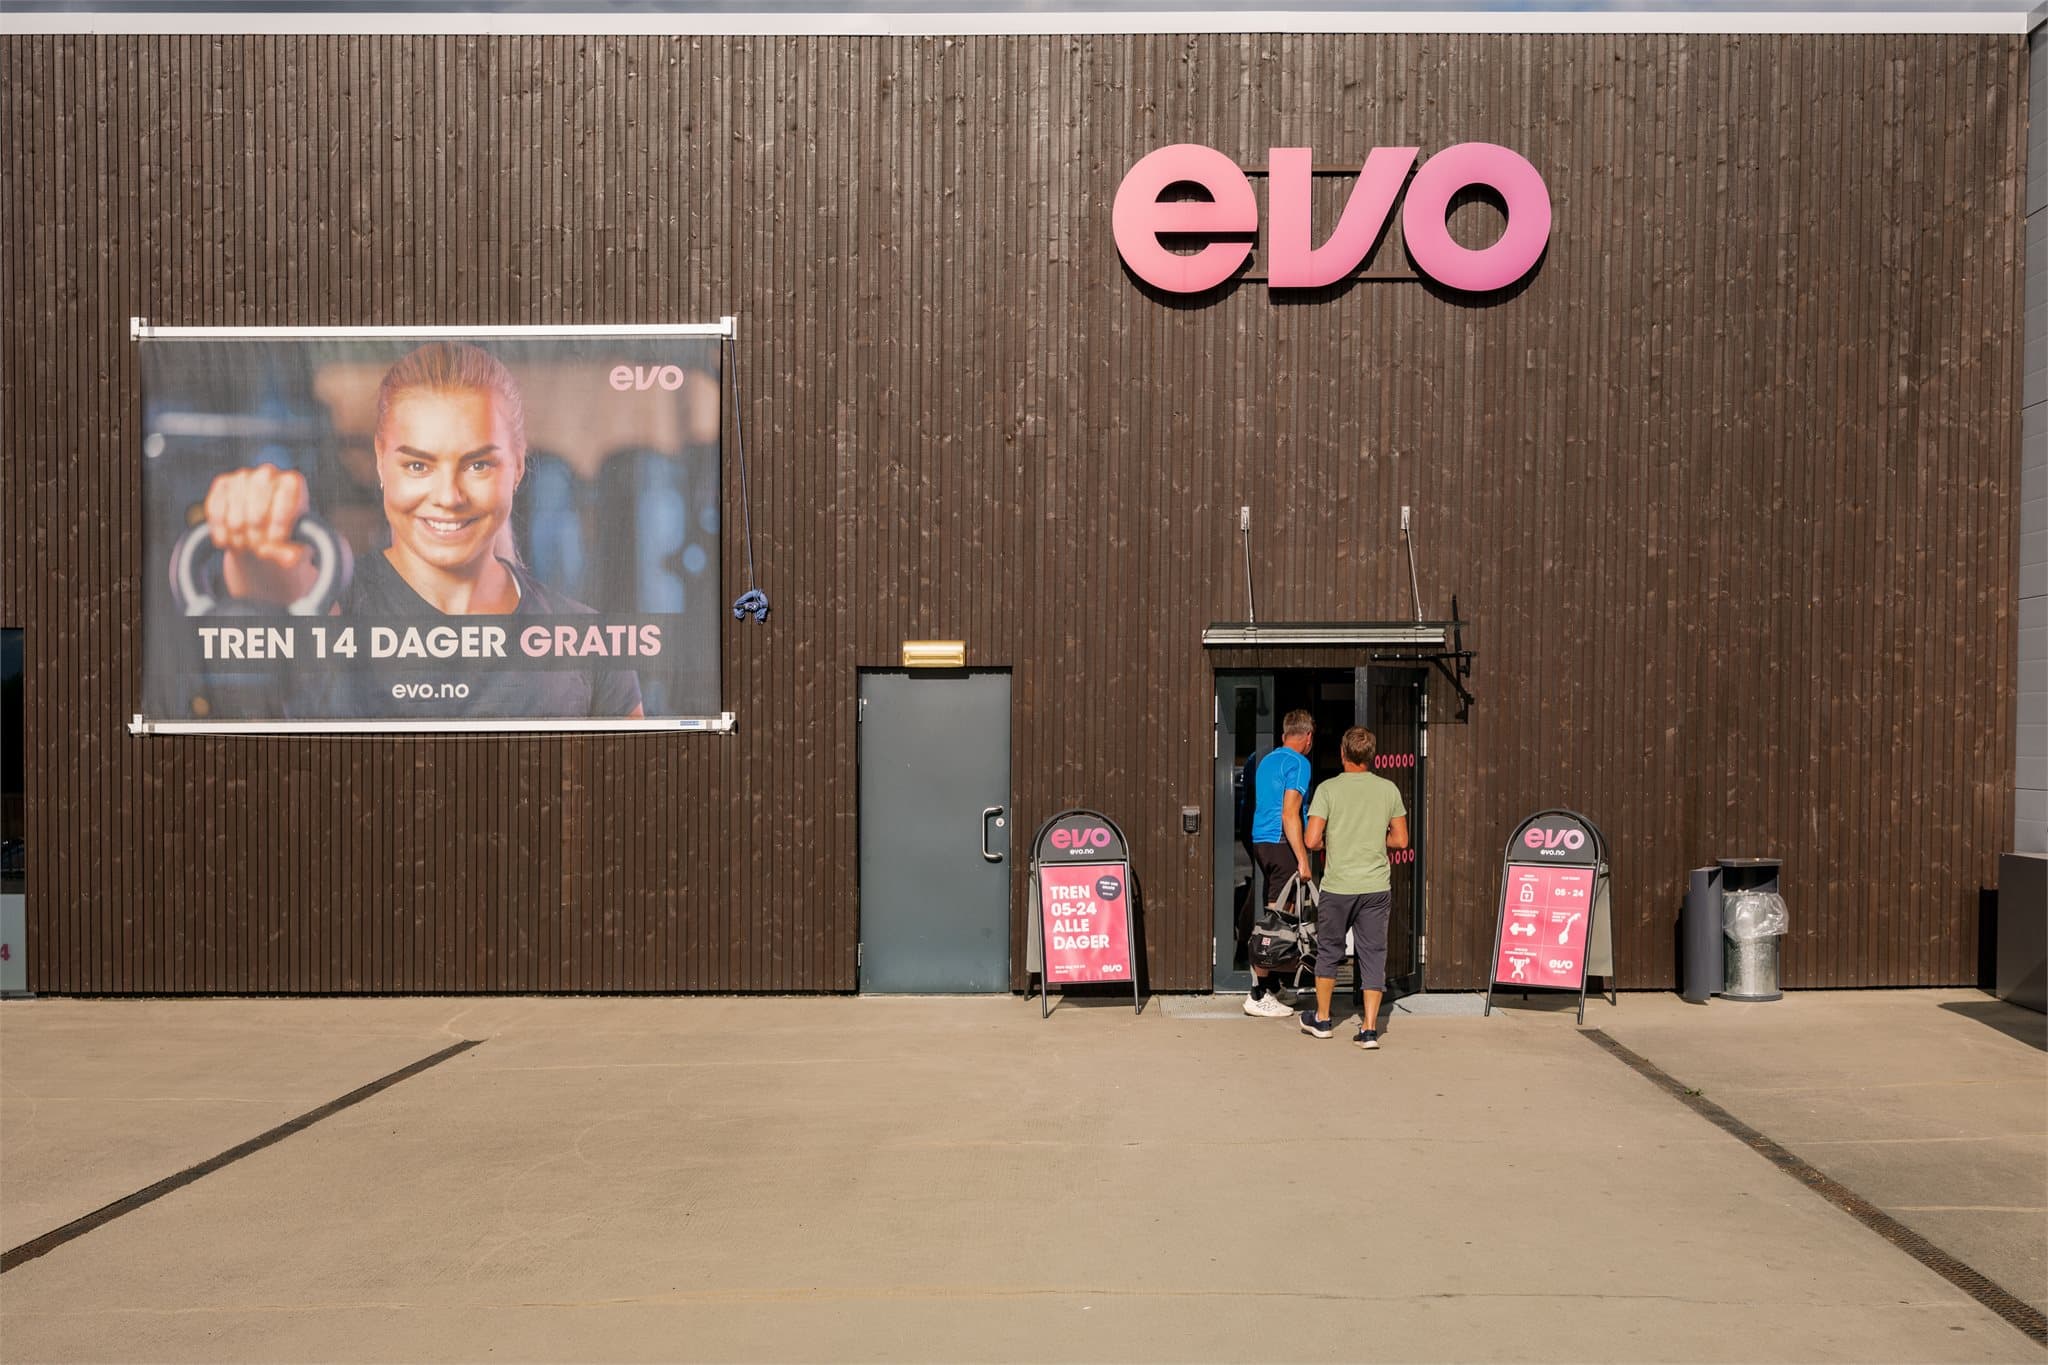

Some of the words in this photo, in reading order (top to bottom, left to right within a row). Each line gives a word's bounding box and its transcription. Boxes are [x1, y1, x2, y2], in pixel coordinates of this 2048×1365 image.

[1112, 142, 1552, 293] evo
[609, 365, 684, 392] evo
[198, 627, 294, 660] TREN
[310, 627, 358, 660] 14
[371, 625, 506, 659] DAGER
[519, 625, 662, 658] GRATIS
[391, 682, 470, 700] evo.no
[1051, 827, 1111, 849] evo
[1524, 827, 1585, 850] evo
[1540, 849, 1565, 857] evo.no
[1050, 886, 1090, 899] TREN
[1051, 902, 1097, 916] 05-24
[1052, 919, 1090, 933] ALLE
[1053, 935, 1110, 950] DAGER
[1102, 964, 1122, 973] evo
[1549, 959, 1573, 969] evo
